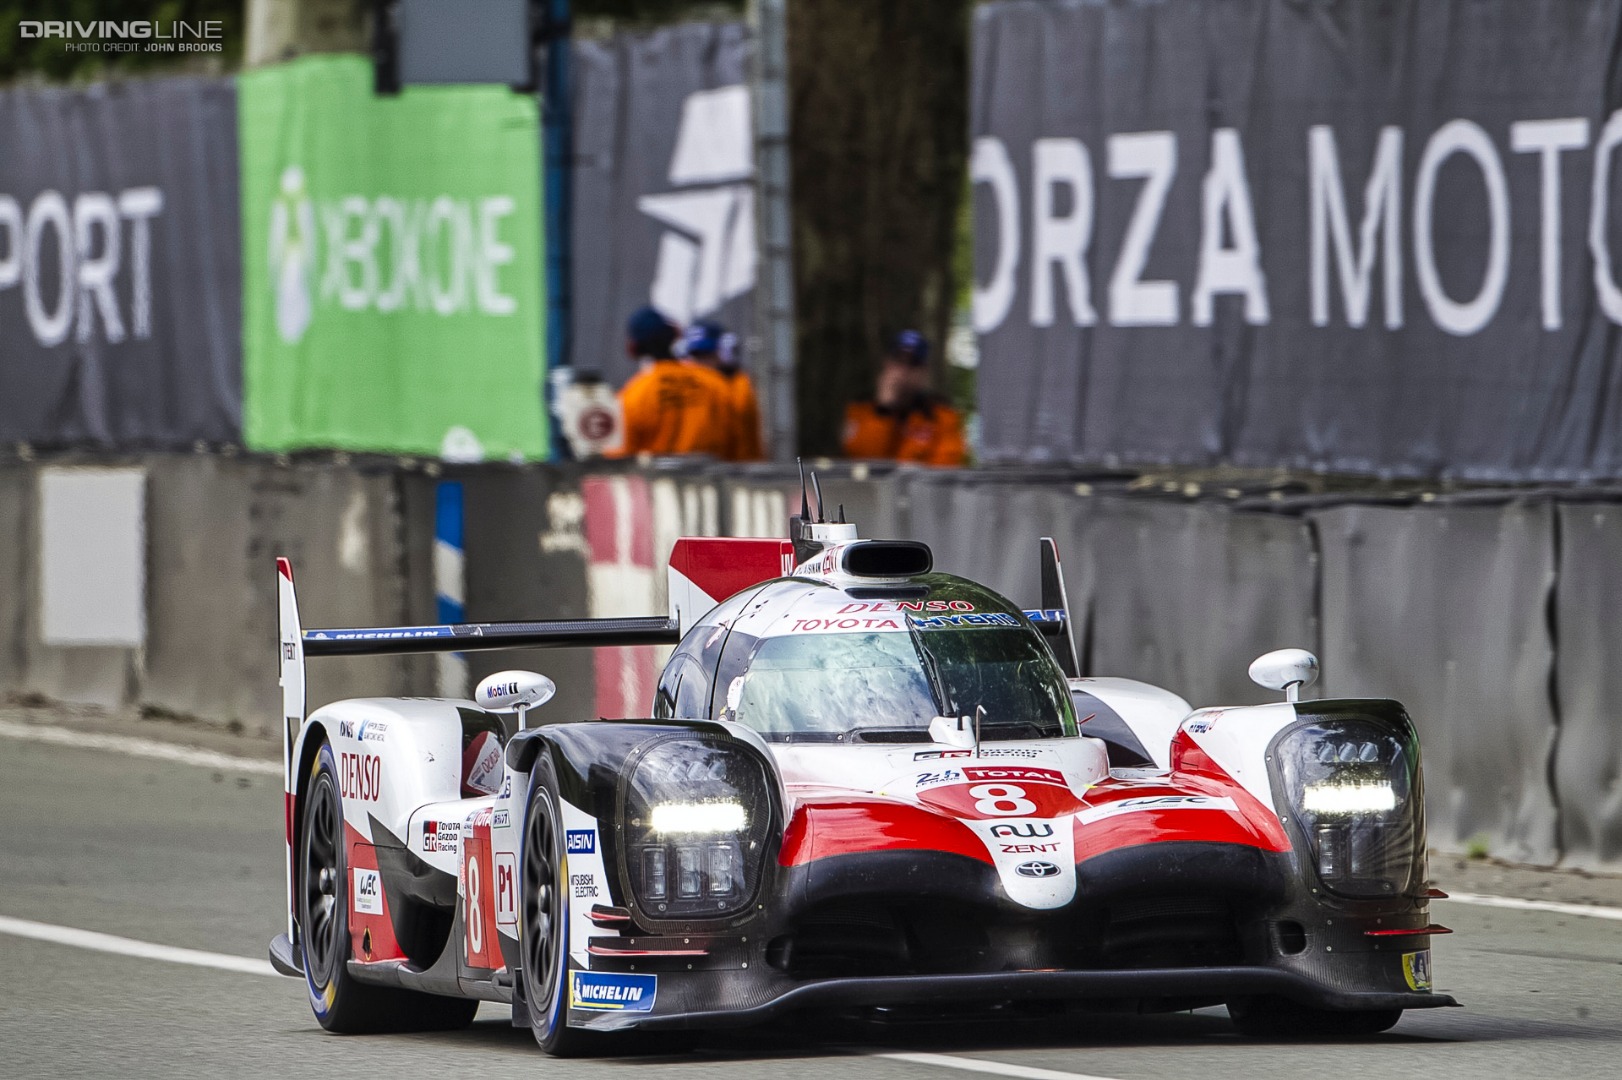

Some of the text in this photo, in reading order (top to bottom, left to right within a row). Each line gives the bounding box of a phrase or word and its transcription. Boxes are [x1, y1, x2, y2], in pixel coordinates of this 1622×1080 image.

[837, 600, 975, 614] DENSO
[791, 618, 899, 632] TOYOTA
[487, 683, 507, 699] Mobil
[341, 752, 381, 802] DENSO
[968, 769, 1062, 782] TOTAL
[968, 783, 1037, 816] 8
[438, 821, 460, 831] TOYOTA
[424, 833, 437, 851] GR
[438, 832, 457, 841] GAZOO
[567, 833, 593, 850] AISIN
[438, 842, 457, 854] Racing
[999, 842, 1061, 854] ZENT
[360, 873, 376, 896] WEC
[498, 864, 513, 912] P1
[575, 886, 599, 898] ELECTRIC
[468, 855, 482, 954] 8
[582, 984, 643, 1001] MICHELIN
